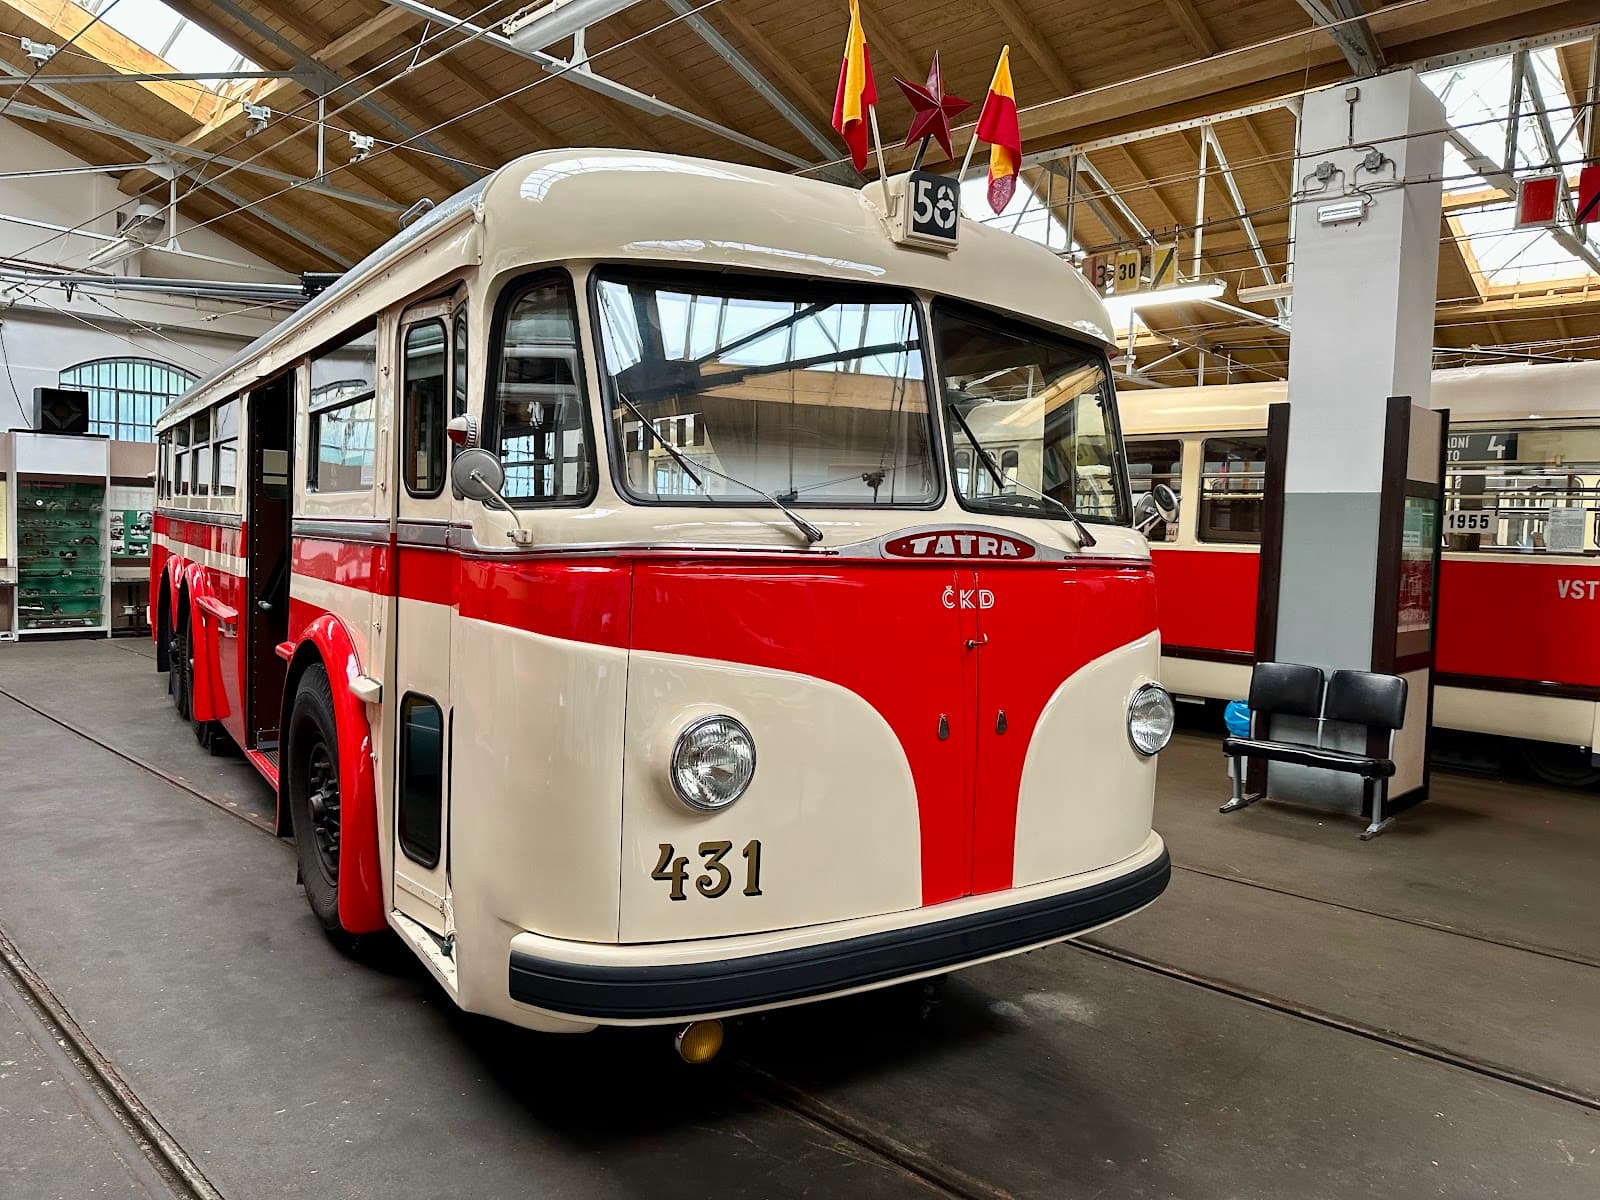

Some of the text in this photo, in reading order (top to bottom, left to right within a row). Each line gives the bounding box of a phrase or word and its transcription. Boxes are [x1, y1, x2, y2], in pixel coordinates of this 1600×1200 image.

[913, 179, 956, 229] 58
[1119, 263, 1136, 281] 30
[1487, 435, 1506, 459] 4
[1449, 514, 1490, 529] 1955
[909, 534, 1018, 557] TATRA
[942, 585, 995, 610] ČKD
[651, 840, 763, 901] 431
